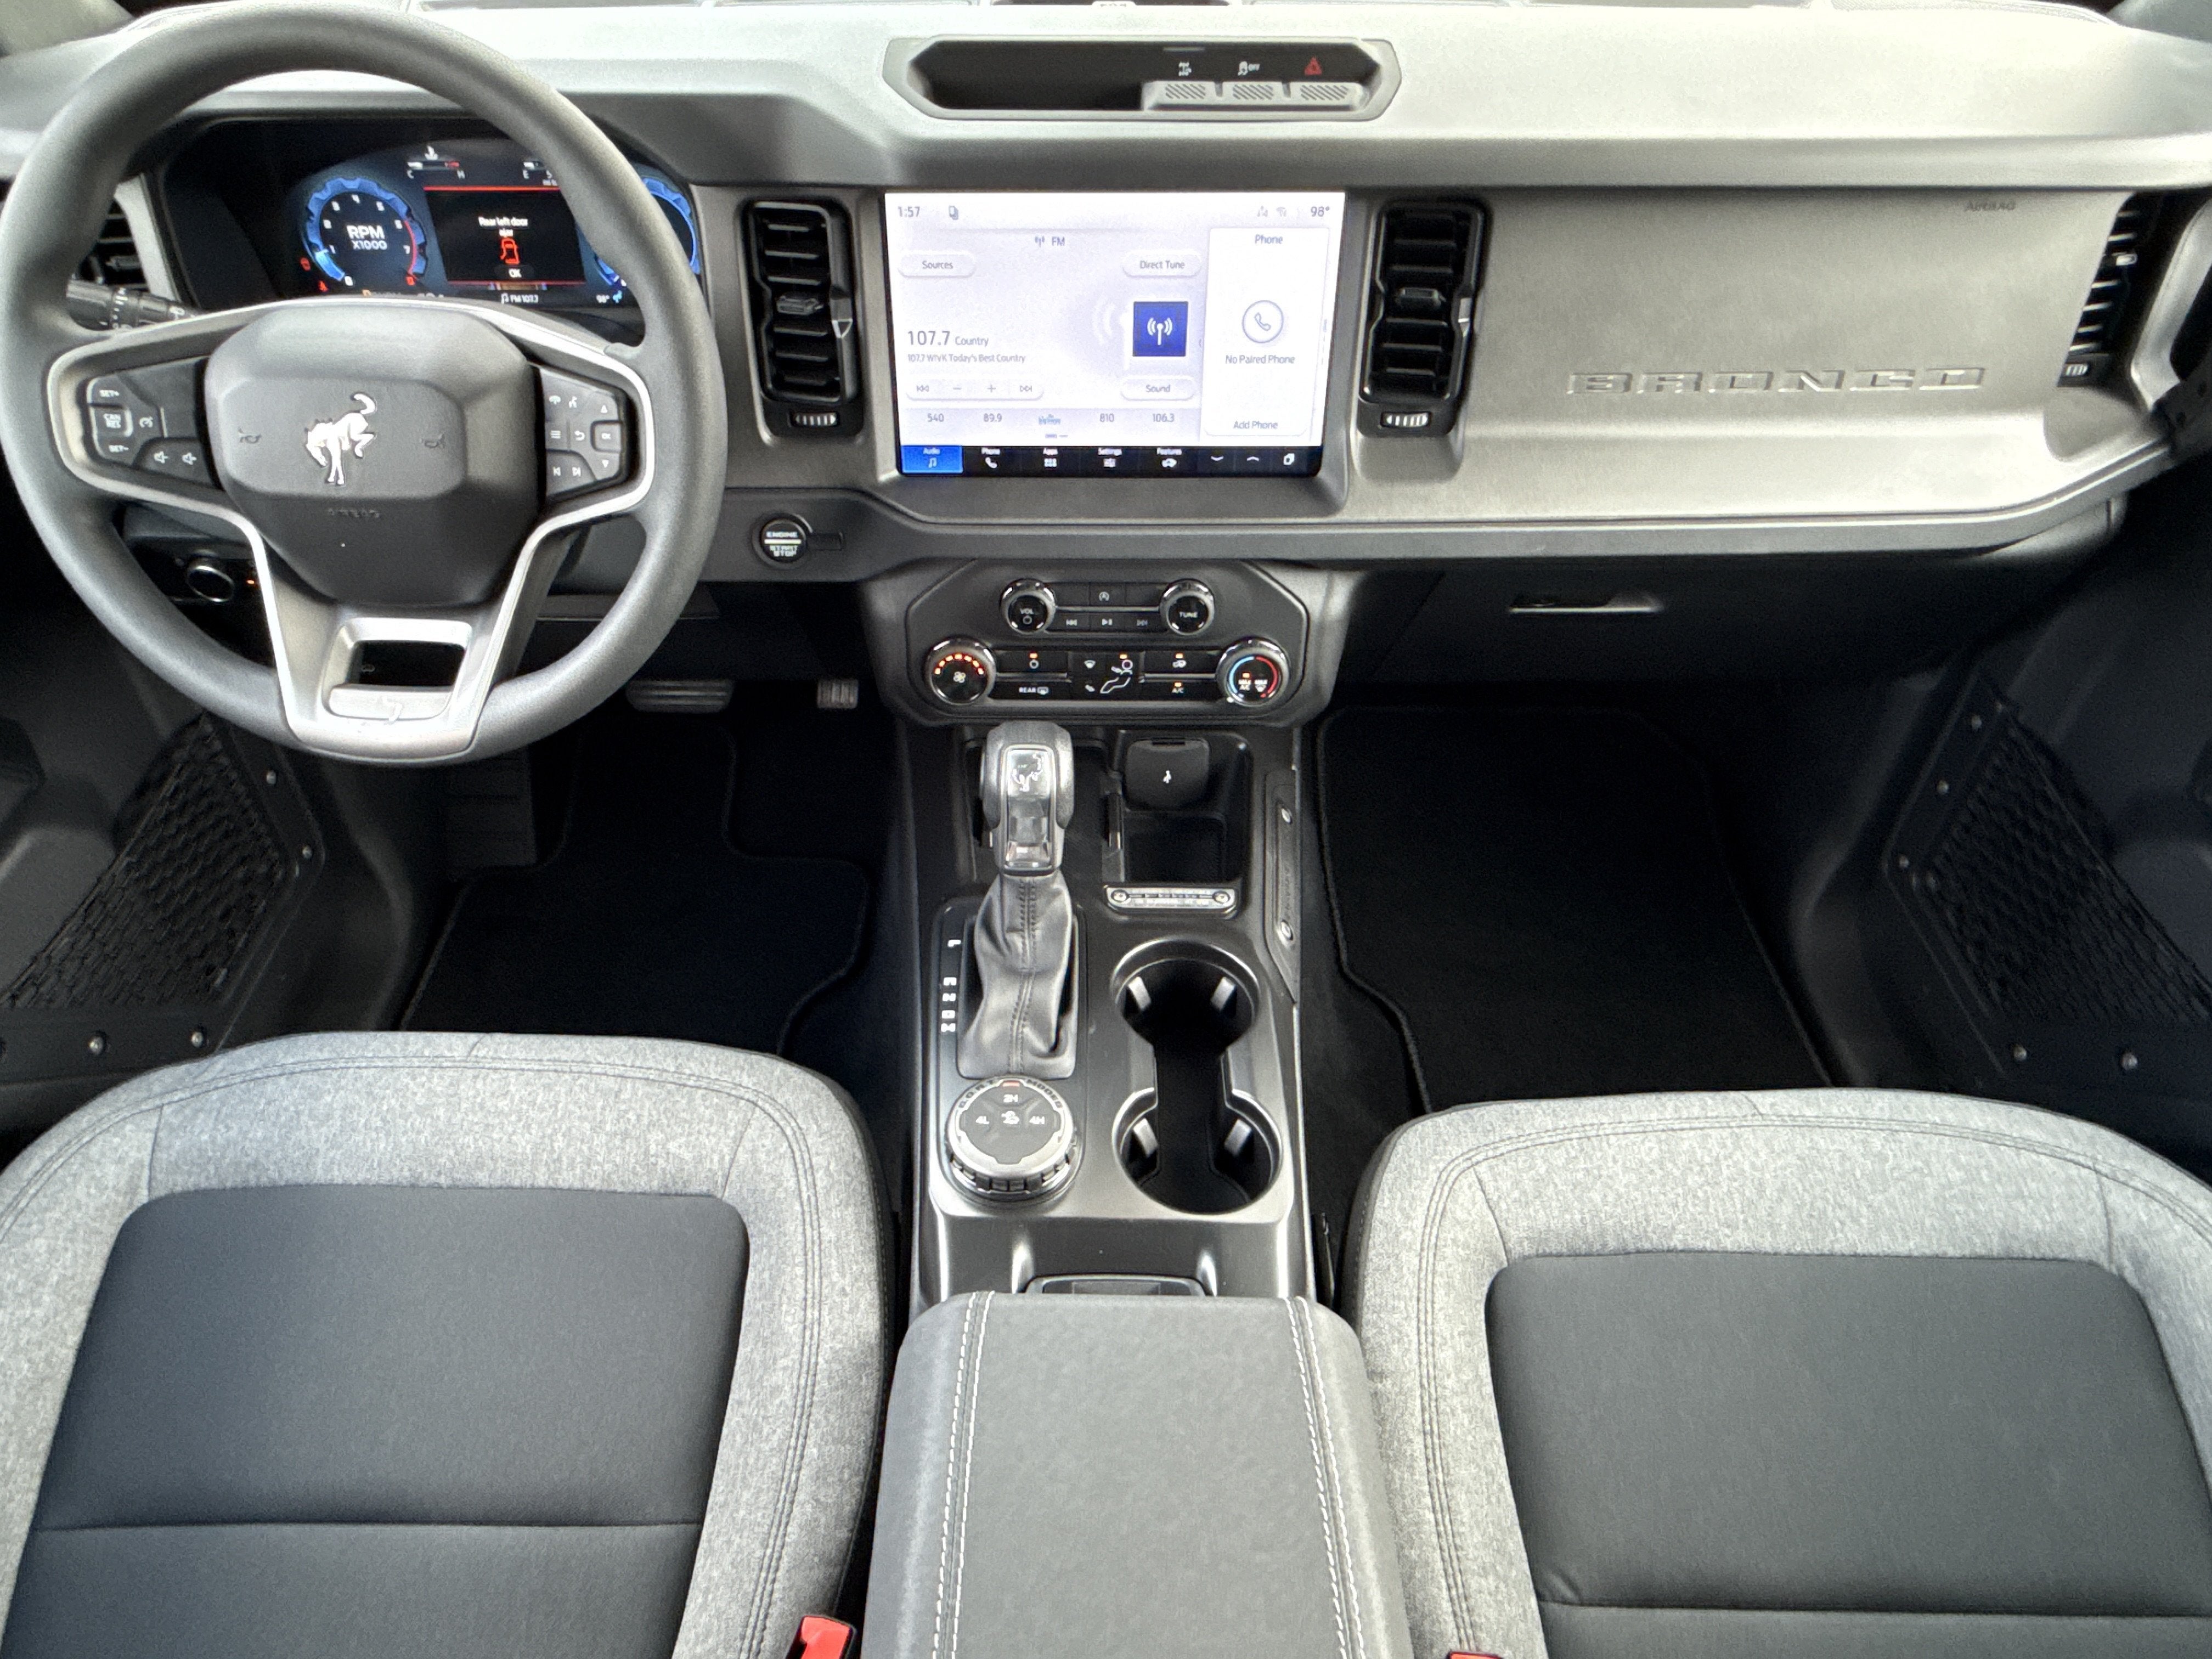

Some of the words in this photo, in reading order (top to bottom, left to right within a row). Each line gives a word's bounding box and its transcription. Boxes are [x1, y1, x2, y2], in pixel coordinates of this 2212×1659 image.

[898, 206, 921, 218] 1:57
[347, 225, 385, 239] RPM
[1051, 236, 1065, 246] FM
[1255, 234, 1284, 245] Phone
[922, 261, 953, 269] Sources
[1139, 261, 1163, 269] Direct
[1165, 261, 1185, 269] Tune
[907, 330, 950, 346] 107.7
[955, 336, 989, 347] Country
[948, 354, 977, 363] Today's
[978, 354, 995, 362] Best
[996, 354, 1026, 363] Country
[1225, 355, 1238, 364] No
[1239, 355, 1266, 364] Paired
[1268, 355, 1295, 364] Phone
[1566, 368, 1986, 393] BRONCO
[1146, 385, 1171, 393] Sound
[927, 413, 945, 422] 540
[983, 413, 1003, 422] 89.9
[1099, 414, 1115, 422] 810
[1152, 414, 1174, 422] 106.3
[1233, 421, 1250, 429] Add
[1251, 421, 1278, 429] Phone
[1003, 1094, 1018, 1103] 2H
[975, 1116, 990, 1125] 4L
[1029, 1116, 1046, 1125] 4H
